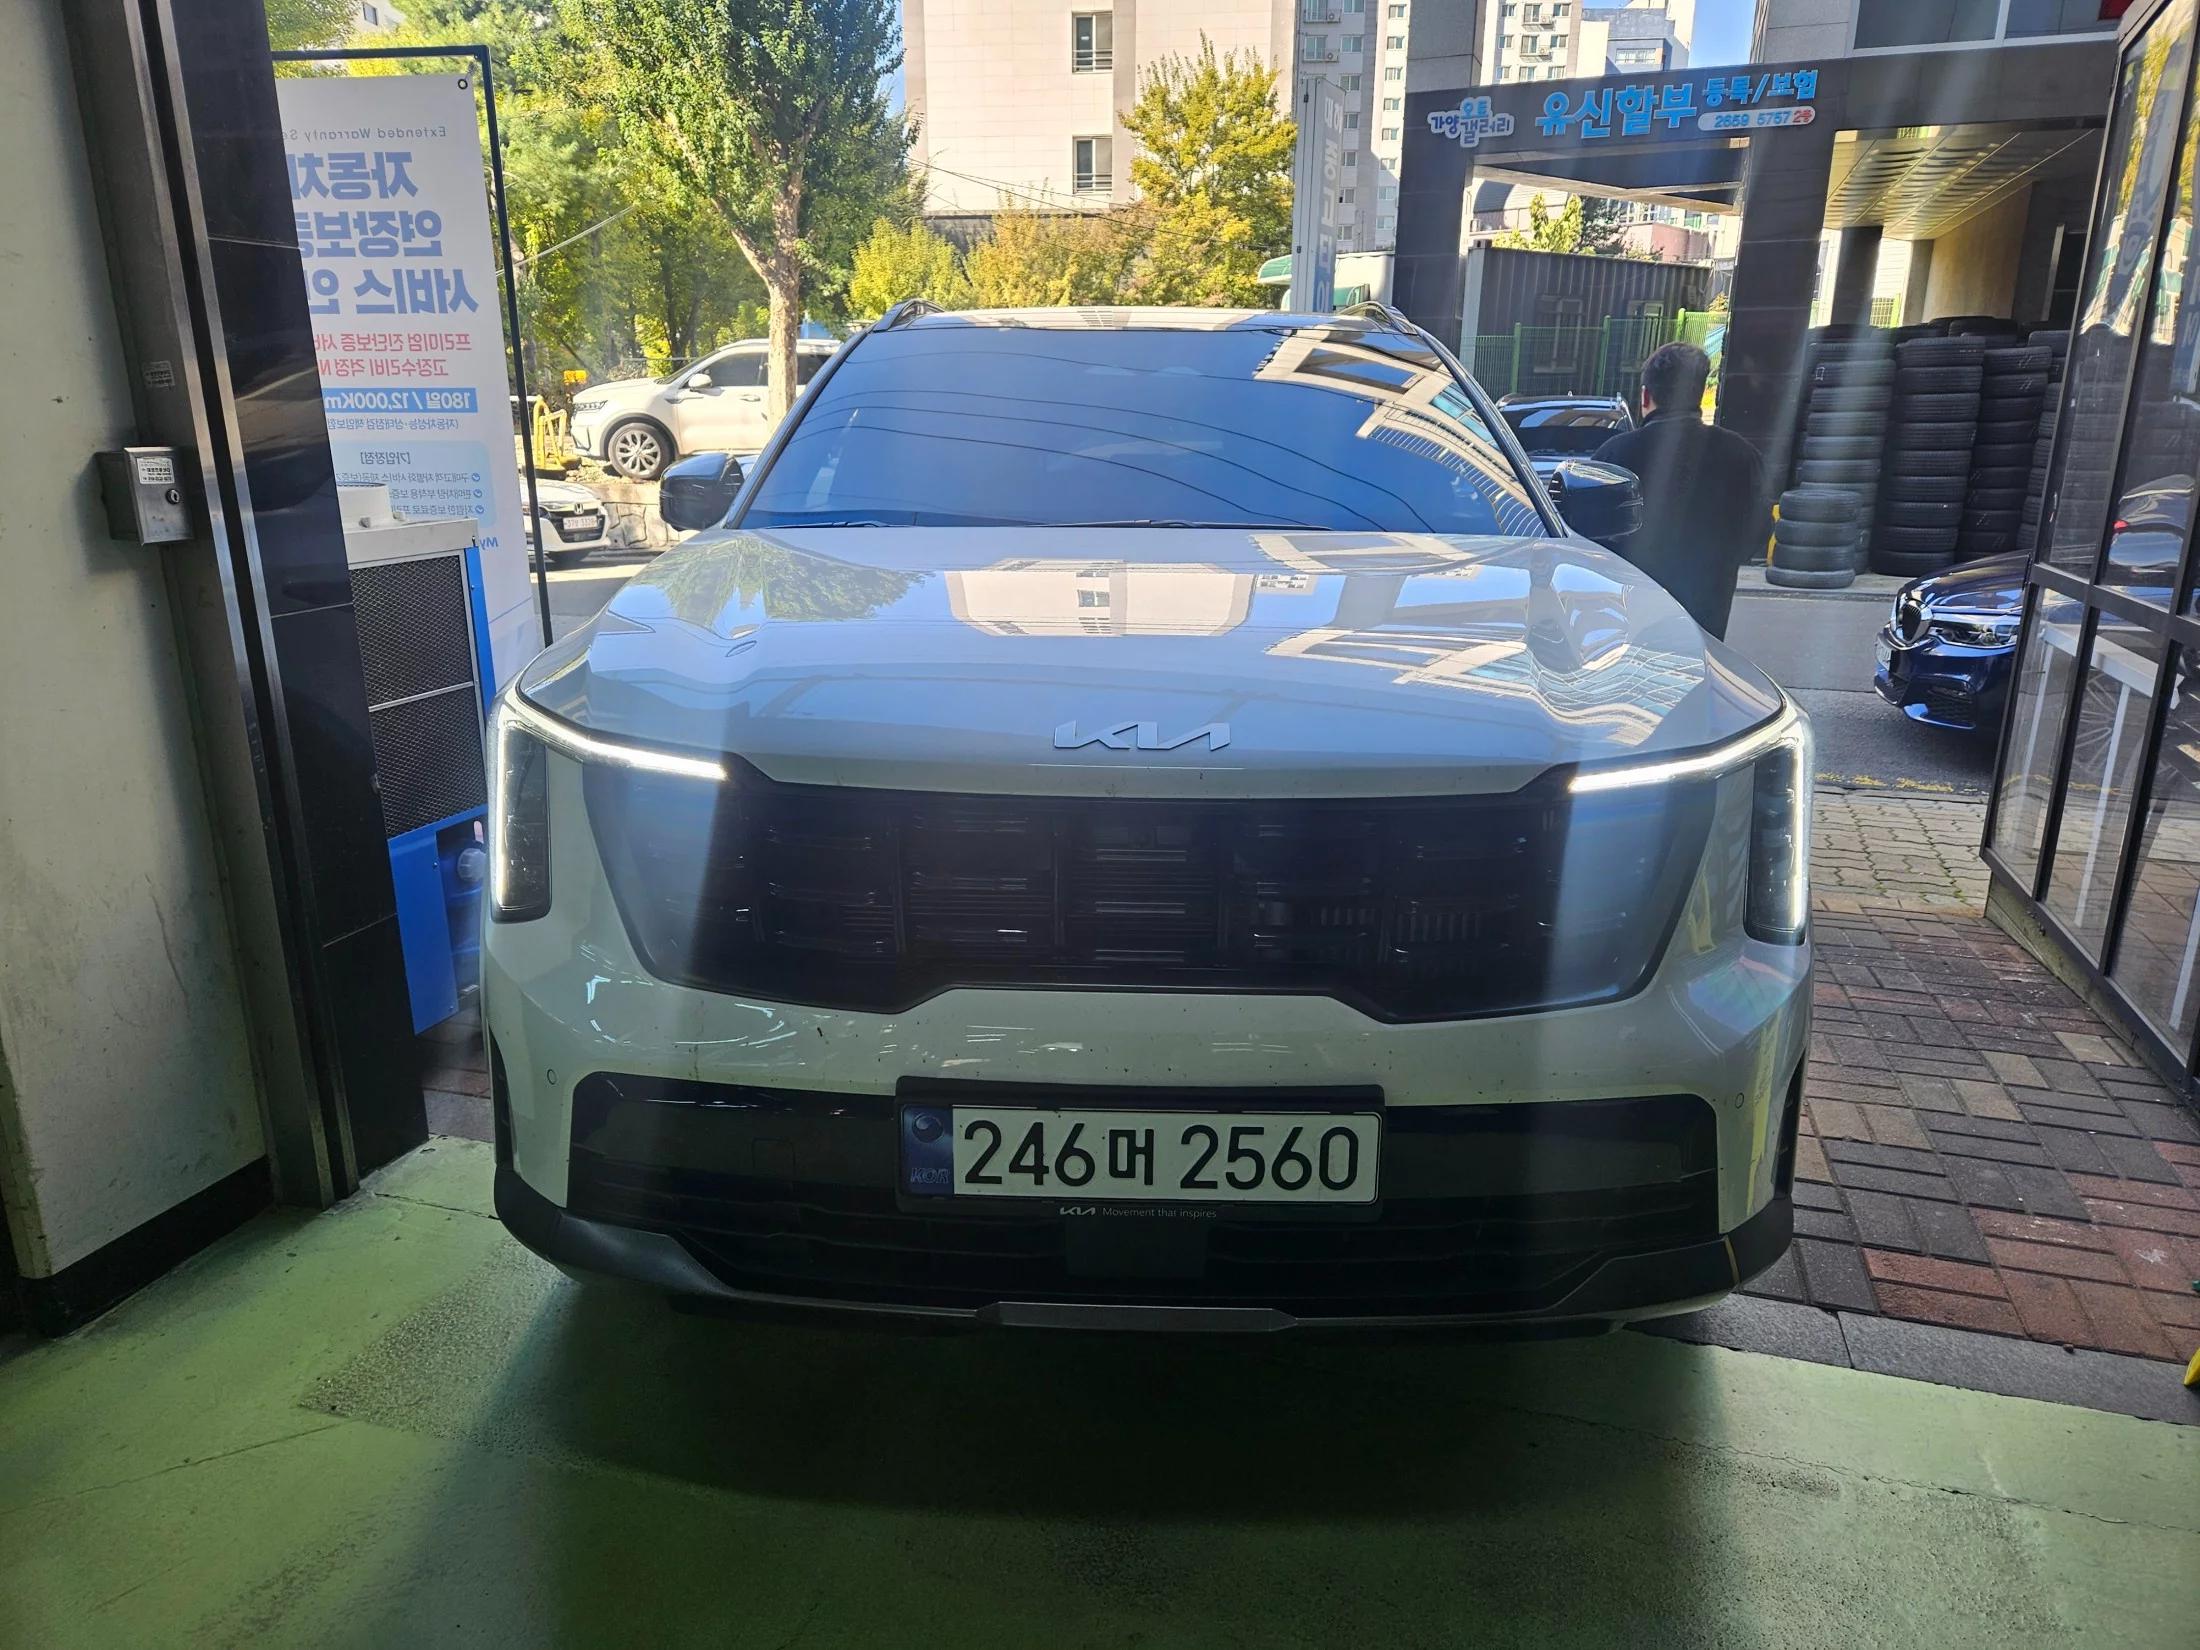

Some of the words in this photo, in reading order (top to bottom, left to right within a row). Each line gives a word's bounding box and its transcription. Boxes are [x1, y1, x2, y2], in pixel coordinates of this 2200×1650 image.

[1535, 83, 1698, 139] 유신할부
[1431, 114, 1460, 135] 가양
[1054, 720, 1231, 752] KIA
[962, 1119, 1155, 1188] 246머
[1179, 1124, 1359, 1191] 2560
[911, 1168, 949, 1184] KOR
[1059, 1206, 1096, 1216] KIA
[1102, 1207, 1155, 1217] Movement
[1158, 1207, 1177, 1217] that
[1180, 1208, 1217, 1220] inspires
